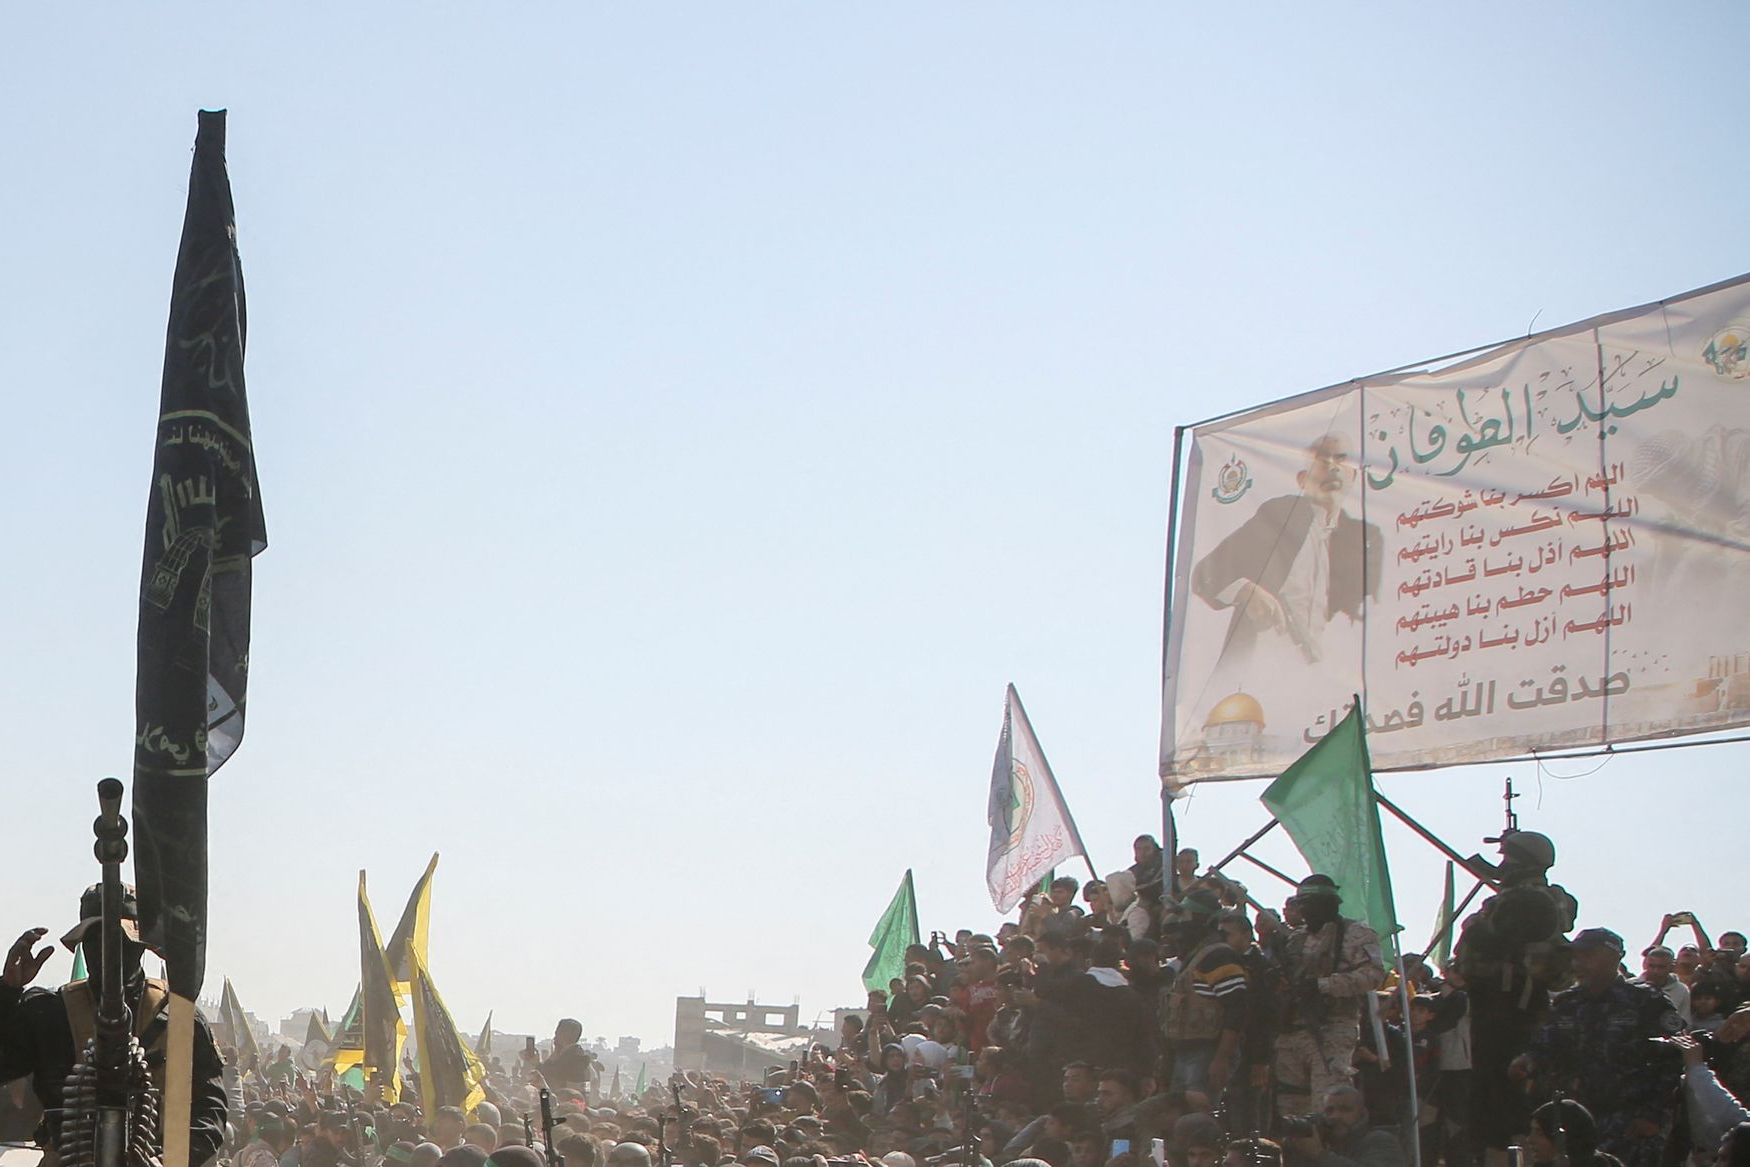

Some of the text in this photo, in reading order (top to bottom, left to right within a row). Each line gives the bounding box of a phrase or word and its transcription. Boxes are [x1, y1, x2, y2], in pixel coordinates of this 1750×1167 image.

[1396, 489, 1479, 533] شوكتهم
[1479, 487, 1507, 509] بنا
[1397, 531, 1454, 567] رايتهم
[1460, 524, 1485, 549] بنا
[1397, 558, 1478, 600] قادتهم
[1483, 551, 1524, 578] بنا
[1466, 594, 1491, 620] بنا
[1496, 585, 1553, 617] حطم
[1396, 603, 1460, 636] هيبتهم
[1524, 611, 1557, 647] أزل
[1395, 634, 1471, 670] دولتهم
[1479, 624, 1520, 650] بنا
[1303, 664, 1632, 745] صدقت الله فصدك
